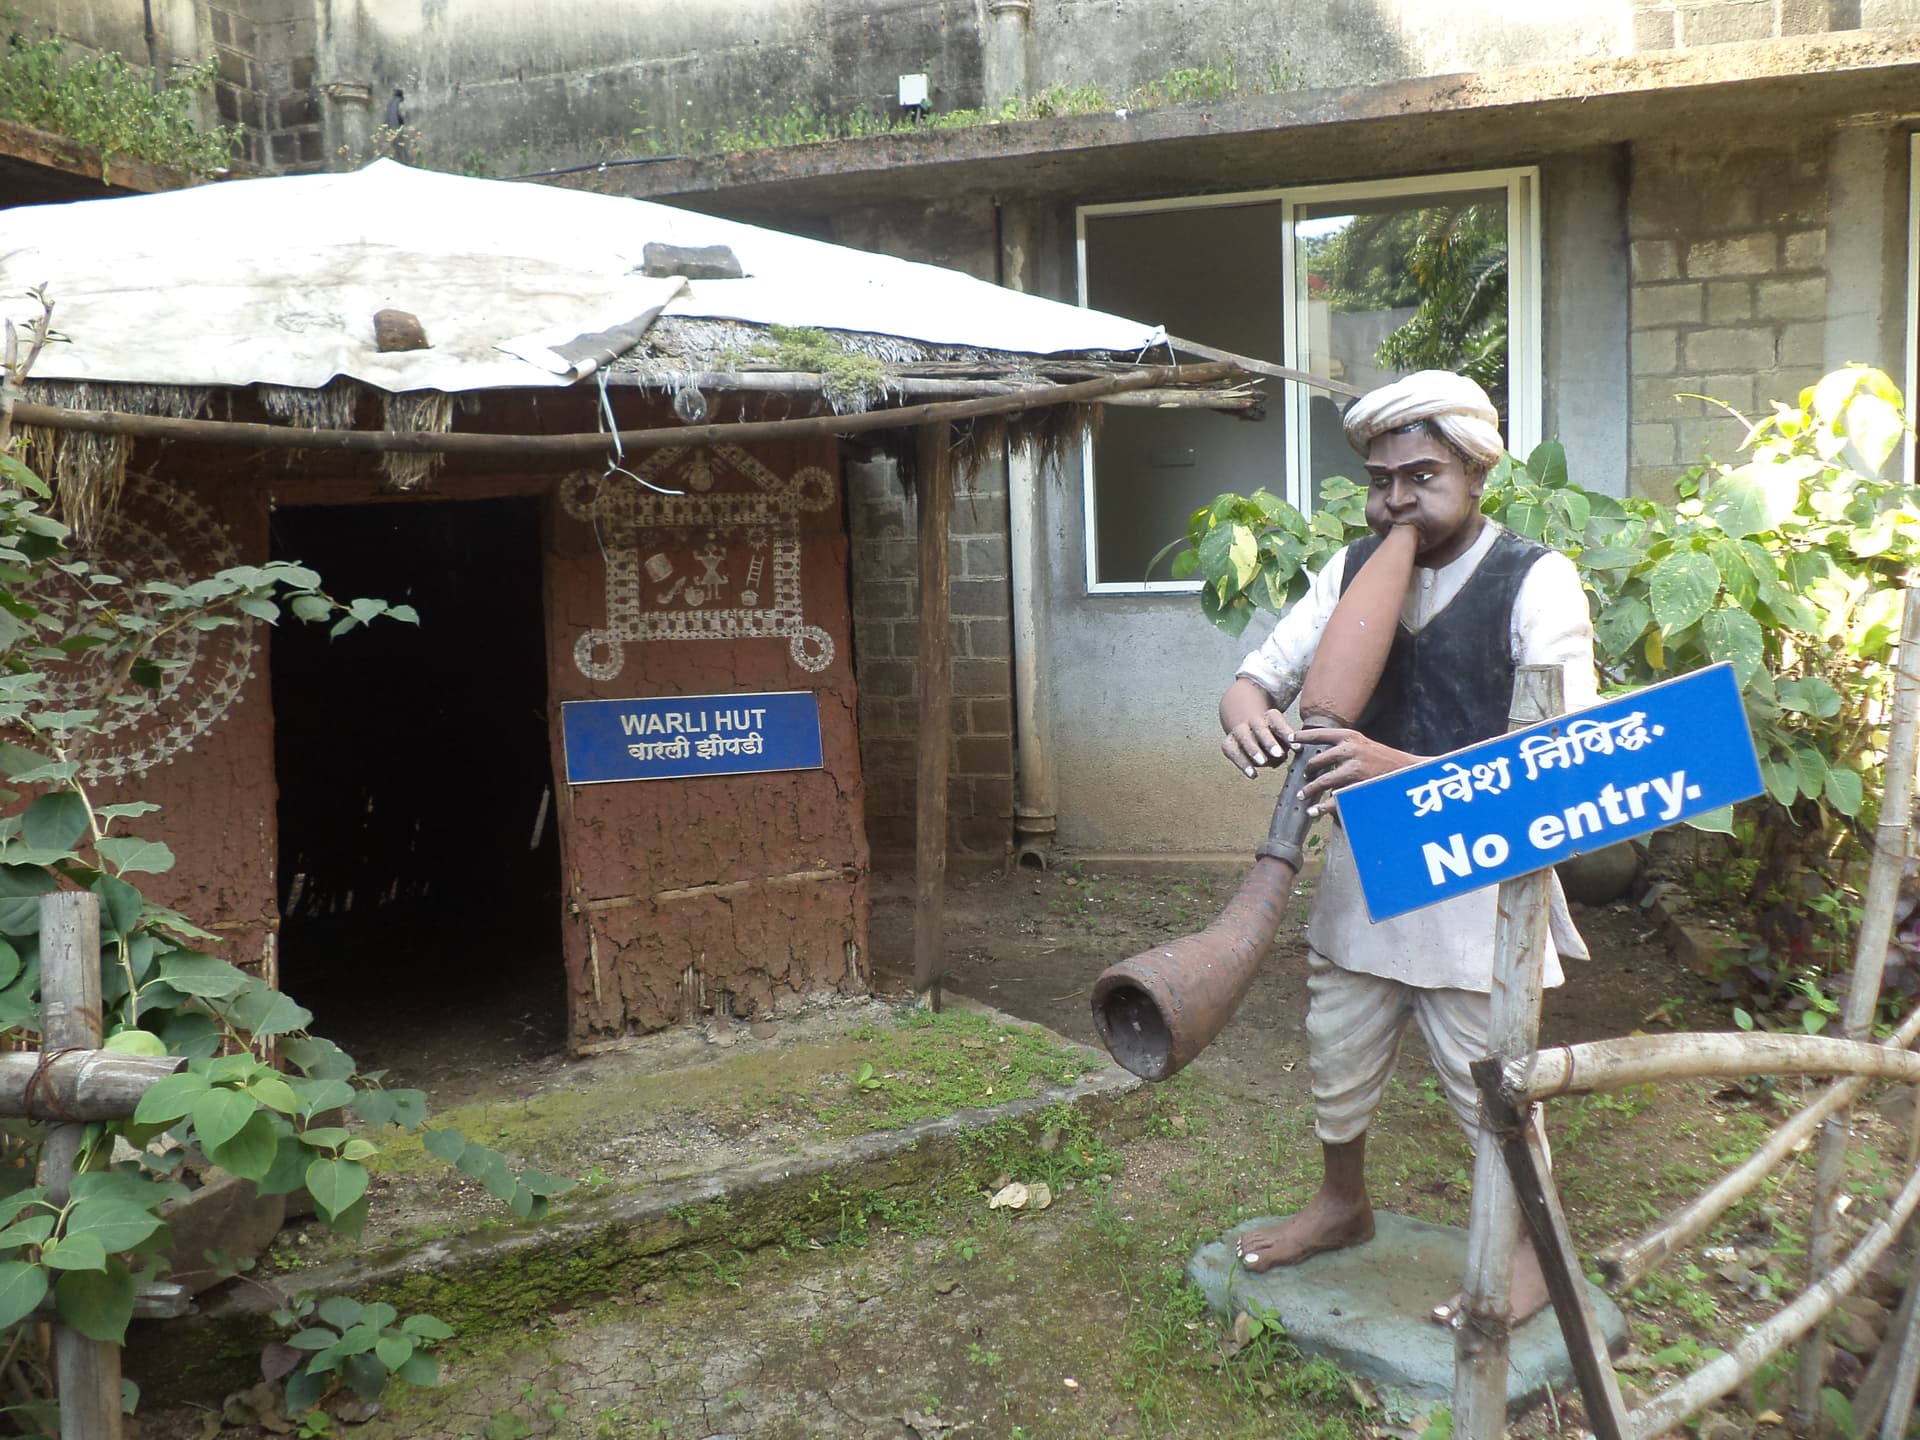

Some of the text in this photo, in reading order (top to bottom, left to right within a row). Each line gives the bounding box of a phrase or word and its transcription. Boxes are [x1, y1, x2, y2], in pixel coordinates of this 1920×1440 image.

[621, 709, 766, 735] WARLI HUT
[628, 735, 691, 761] वारली
[1406, 757, 1511, 817] प्रवेश
[1422, 770, 1702, 886] No entry.
